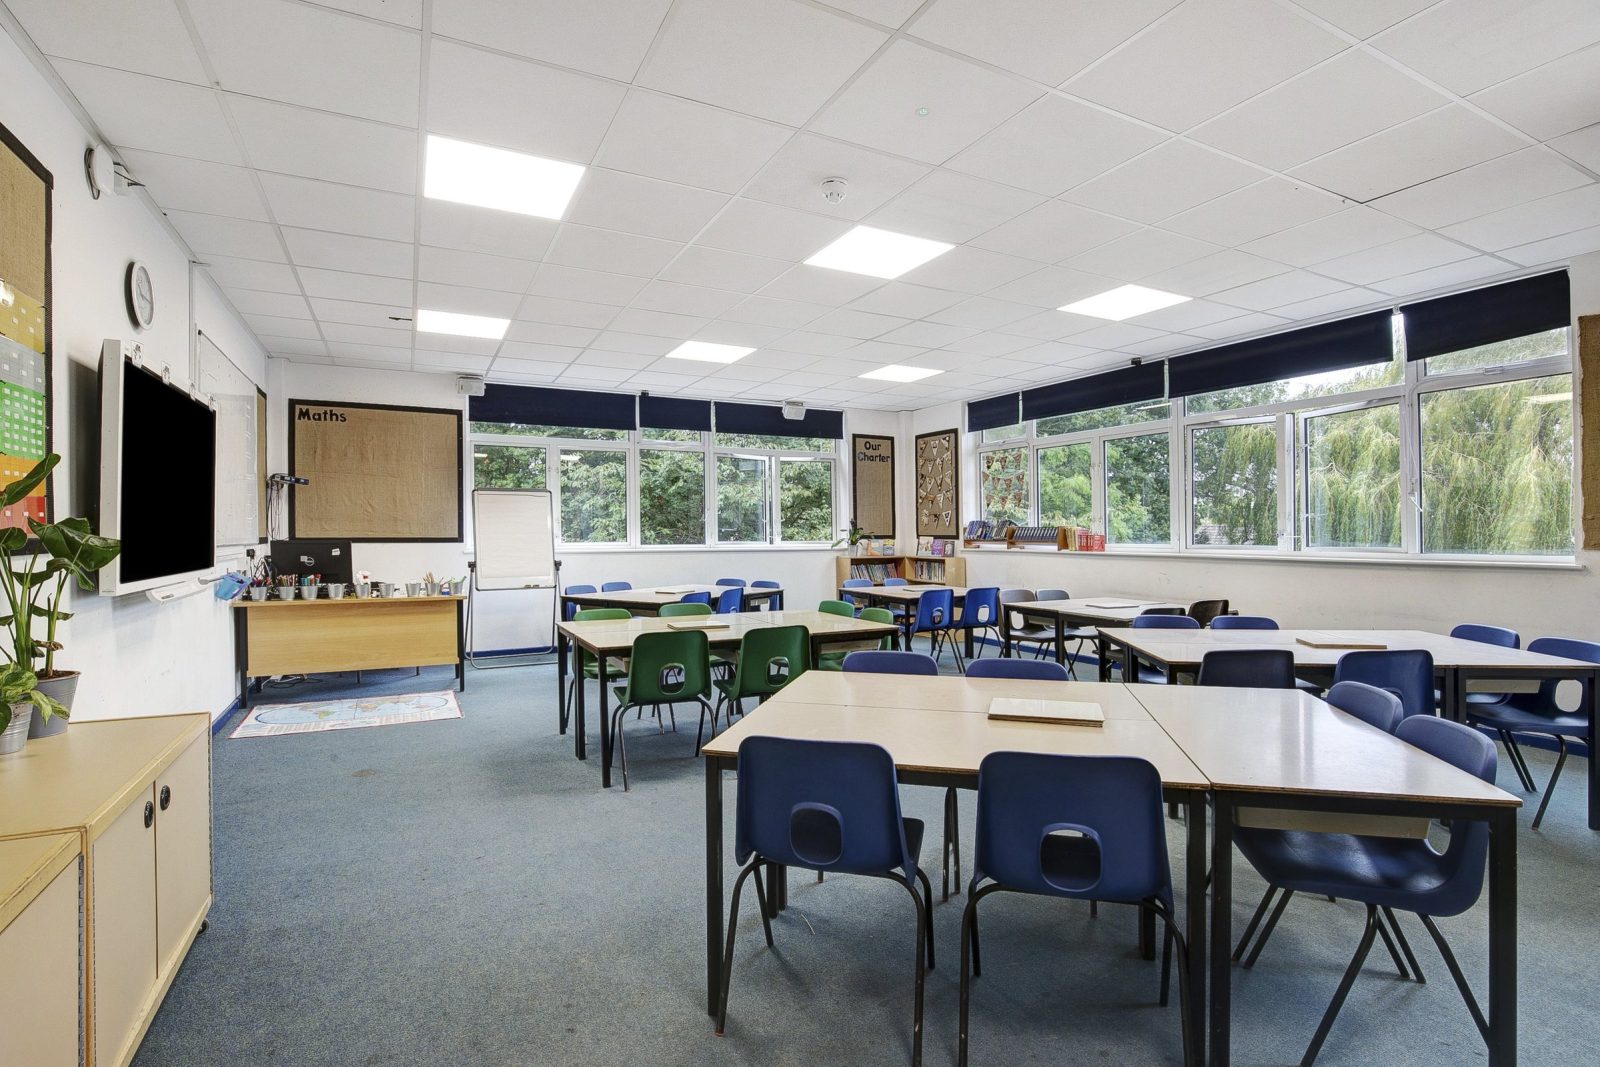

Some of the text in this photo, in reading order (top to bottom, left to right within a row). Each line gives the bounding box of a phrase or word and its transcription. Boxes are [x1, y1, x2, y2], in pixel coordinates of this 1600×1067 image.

[297, 407, 347, 422] Maths
[864, 441, 881, 450] Our
[857, 451, 890, 462] Charter
